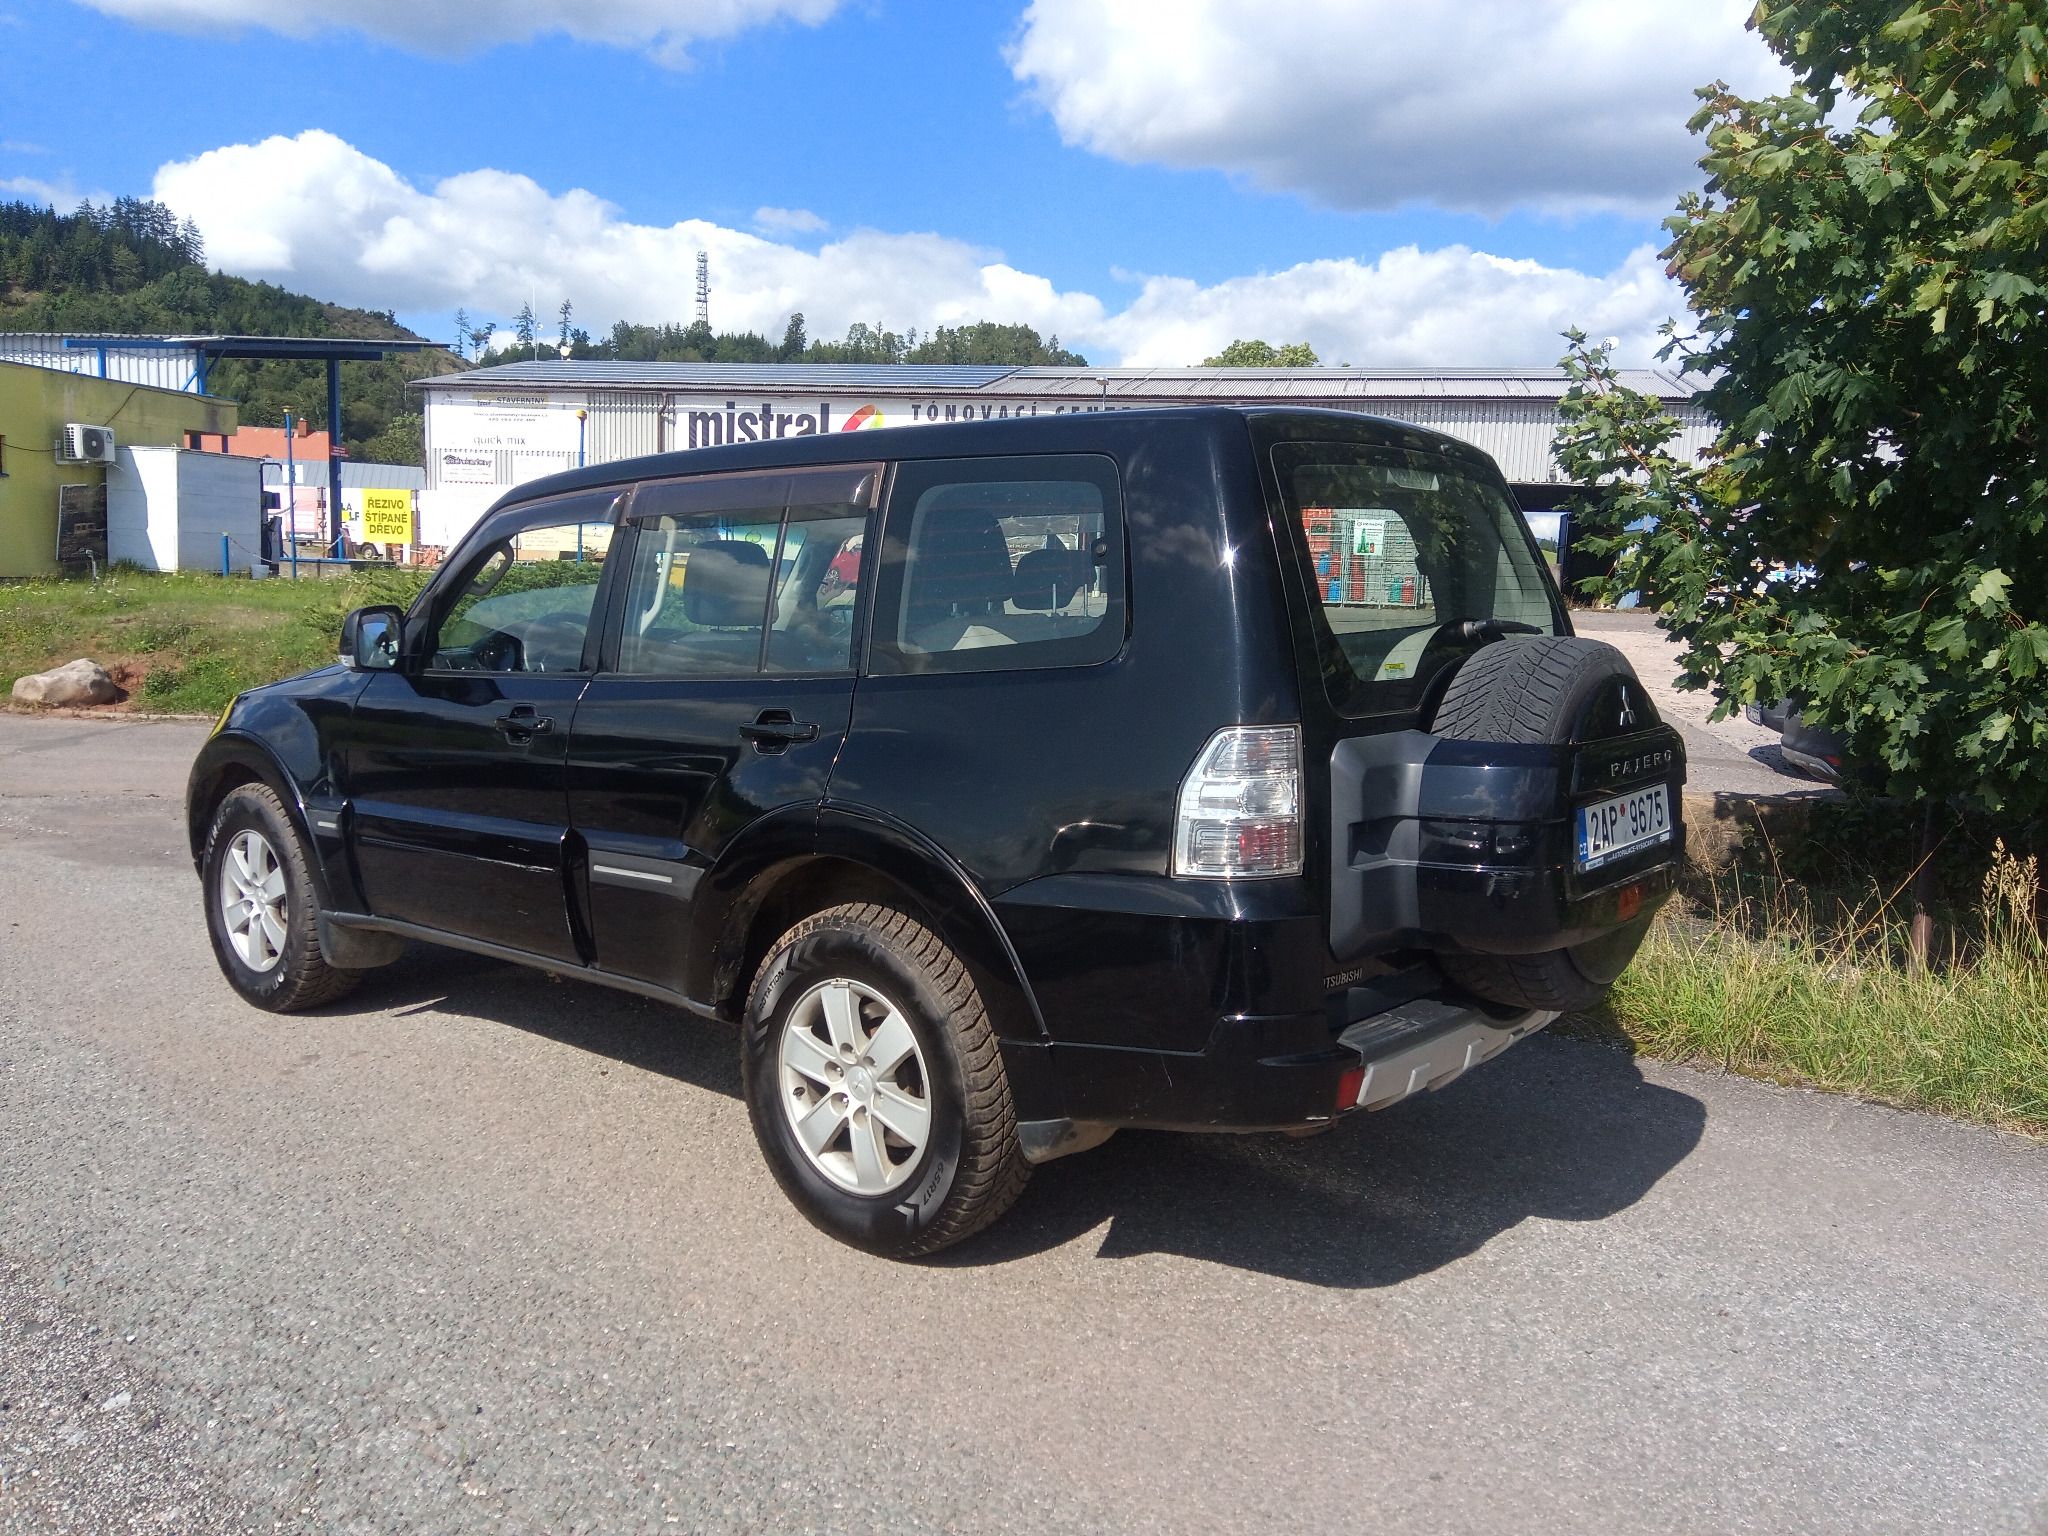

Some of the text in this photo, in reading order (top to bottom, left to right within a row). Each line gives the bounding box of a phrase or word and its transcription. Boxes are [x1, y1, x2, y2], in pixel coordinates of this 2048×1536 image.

[688, 401, 830, 449] mistral
[473, 435, 502, 446] quick
[367, 497, 404, 509] ŘEZIVO
[365, 510, 408, 523] ŠTÍPANÉ
[369, 523, 404, 535] DŘEVO
[1610, 749, 1672, 777] PAJERO
[1590, 790, 1663, 852] 2AP 9675
[1579, 842, 1588, 856] CZ
